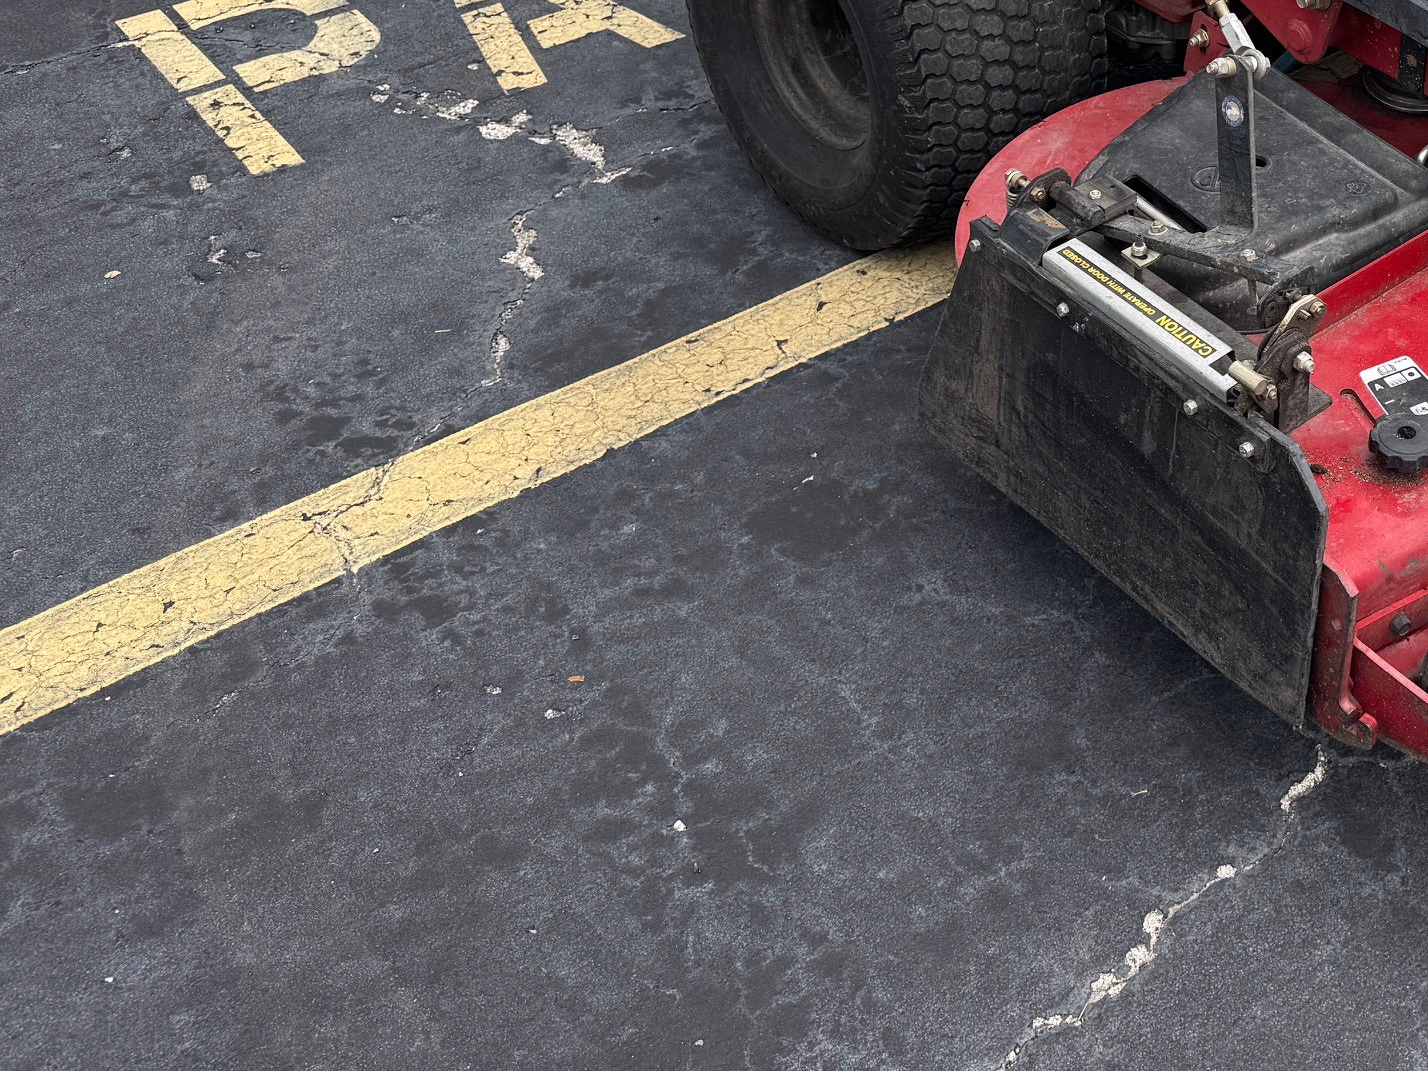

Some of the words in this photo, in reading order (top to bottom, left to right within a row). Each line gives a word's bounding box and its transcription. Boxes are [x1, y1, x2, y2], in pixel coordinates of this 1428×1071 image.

[1062, 249, 1090, 270] CLOSED
[1087, 264, 1109, 284] DOOR
[1105, 277, 1126, 296] WITH
[1122, 290, 1156, 316] OPERATE
[1156, 315, 1214, 357] CAUTION
